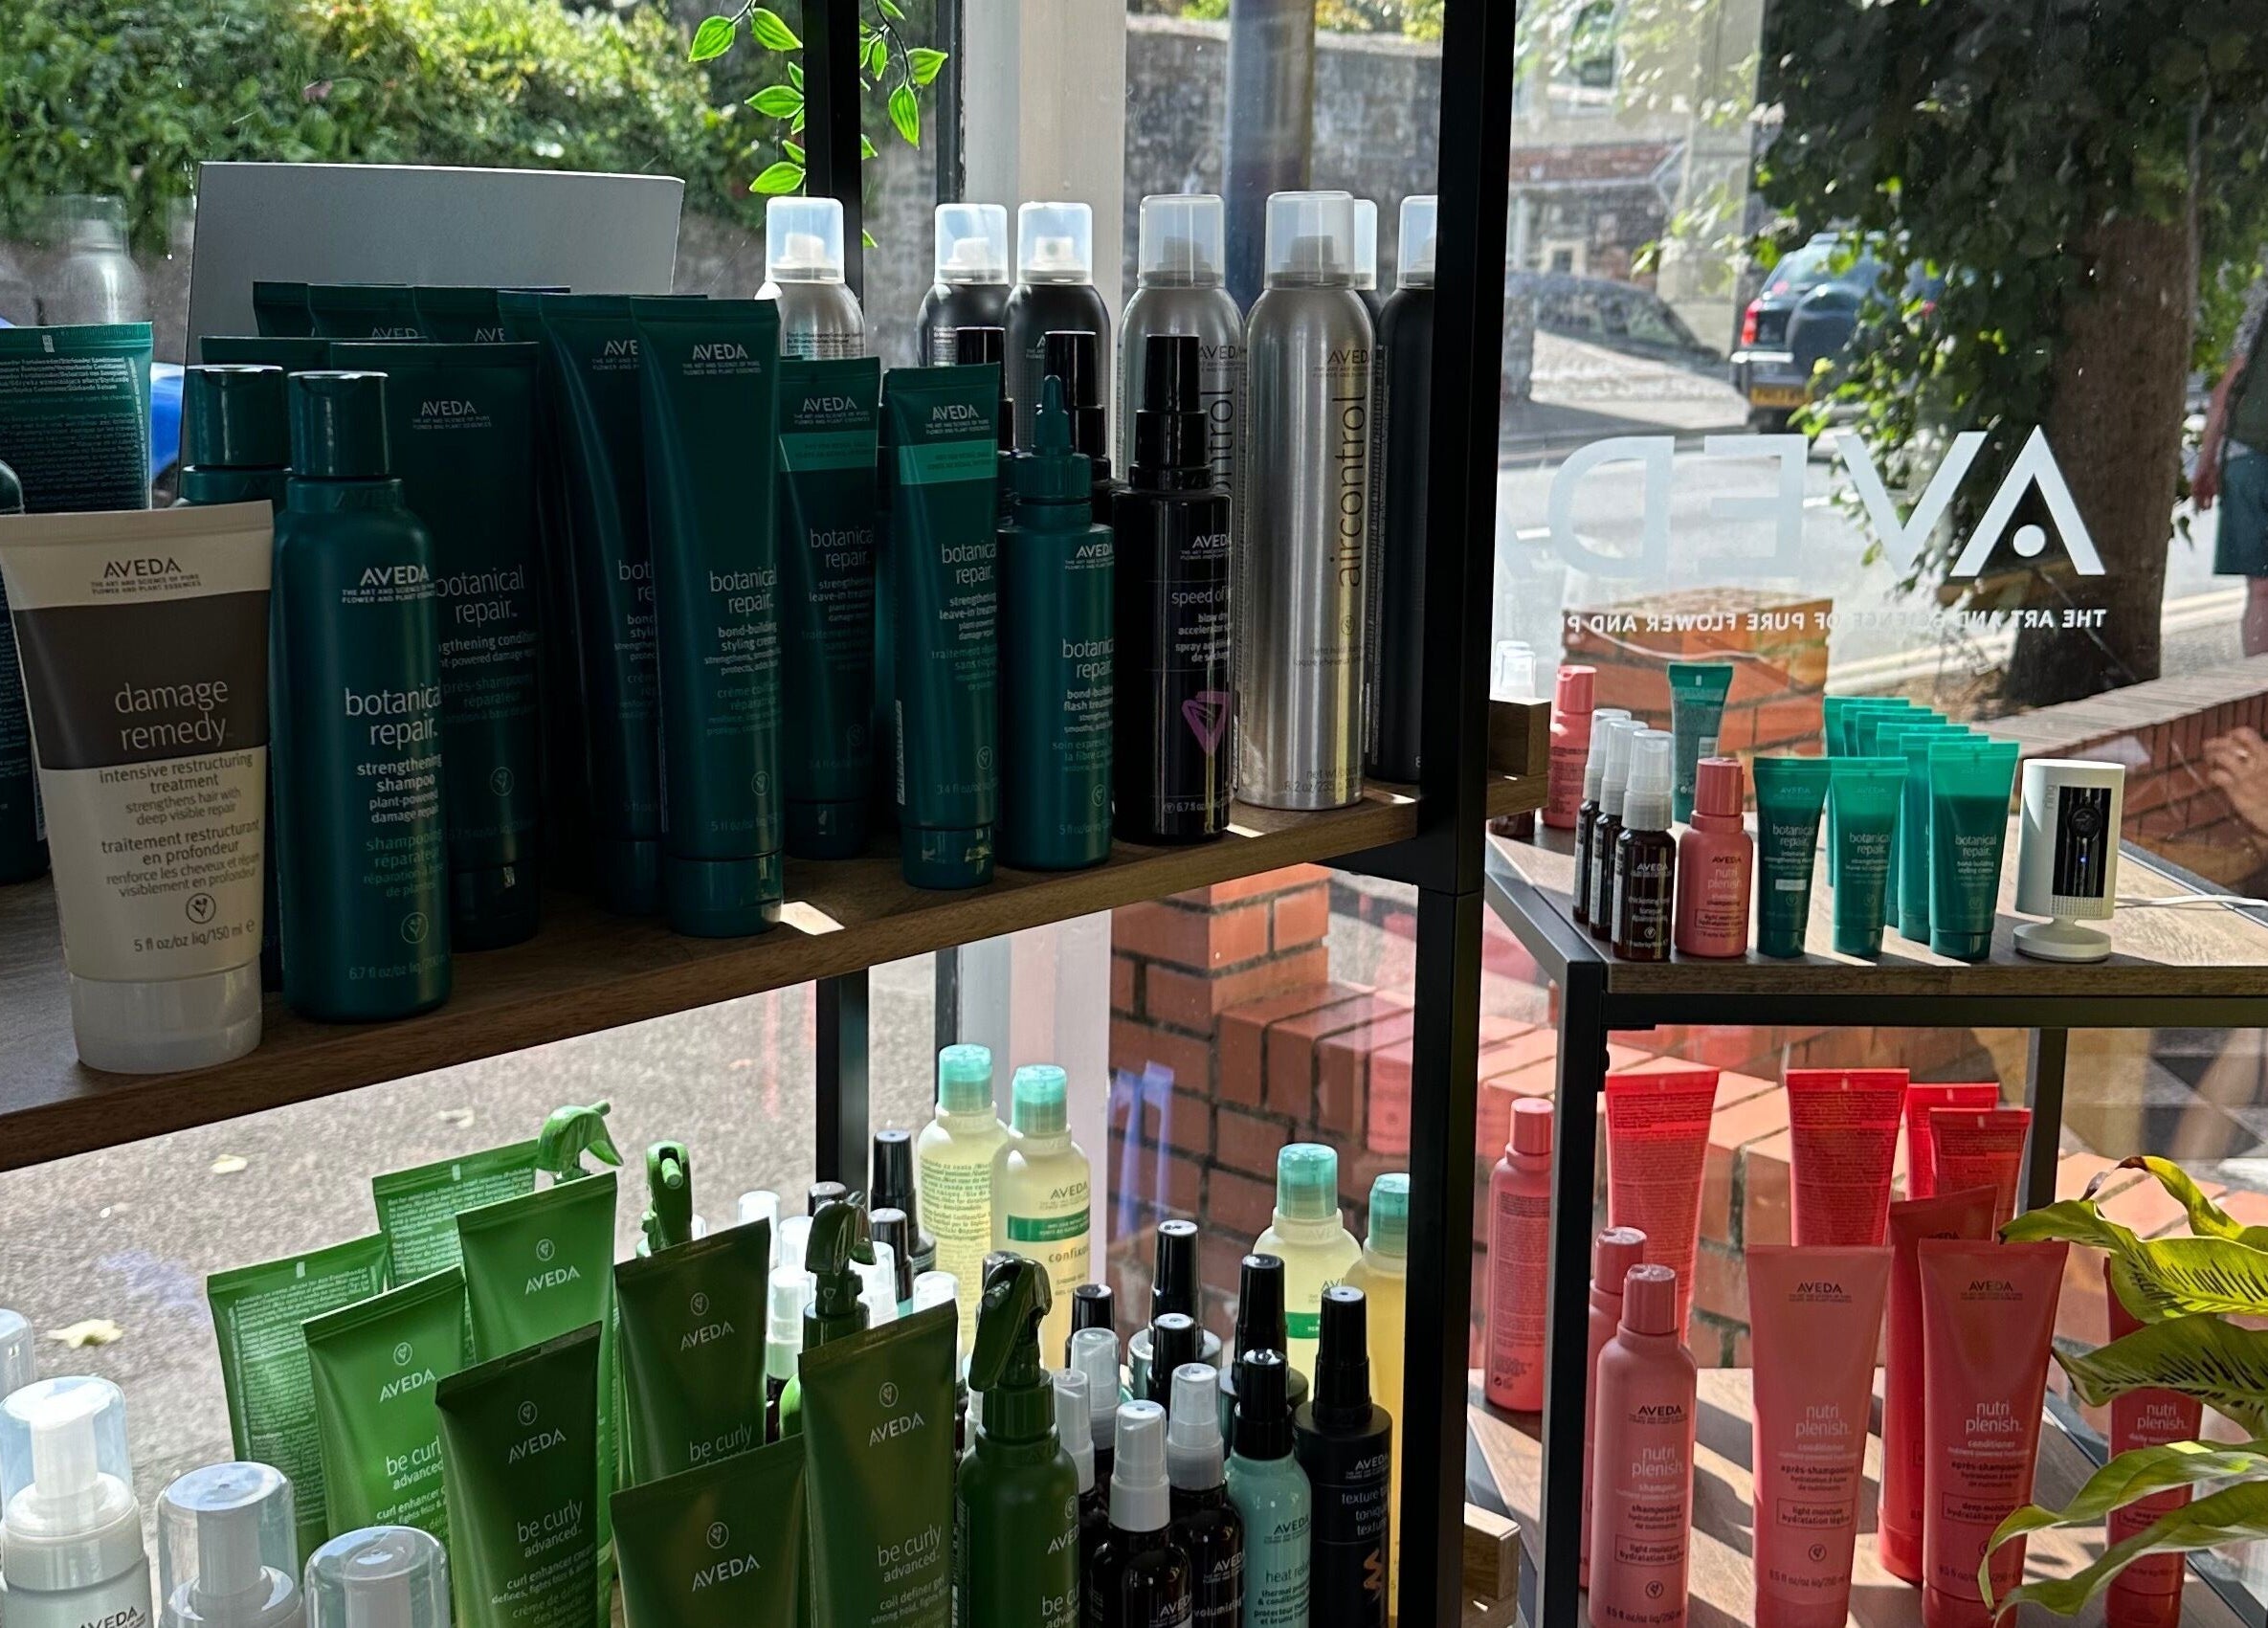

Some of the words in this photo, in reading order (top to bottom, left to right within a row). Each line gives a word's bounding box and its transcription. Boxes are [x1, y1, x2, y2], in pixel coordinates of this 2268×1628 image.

[371, 326, 418, 338] AVED
[474, 328, 505, 342] AVE
[604, 340, 638, 355] AVE
[692, 342, 748, 360] AVEDA
[421, 400, 478, 415] AVEDA
[802, 395, 857, 412] AVEDA
[931, 404, 980, 420] AVEDA
[1330, 394, 1366, 588] aircontrol
[103, 557, 182, 578] AVEDA
[360, 564, 430, 587] AVEDA
[709, 564, 778, 593] botanical
[1171, 587, 1213, 607] speed
[114, 679, 230, 714] damage
[120, 711, 227, 751] remedy
[100, 765, 168, 785] intensive
[171, 753, 254, 777] restructuring
[150, 773, 219, 794] treatment
[376, 773, 436, 793] shampoo
[125, 793, 196, 814] strengthens
[197, 792, 220, 804] hair
[136, 811, 167, 826] deep
[168, 805, 206, 820] visible
[101, 830, 182, 855] traitement
[1955, 834, 1997, 845] botanical
[143, 854, 161, 865] en
[166, 838, 239, 865] profondeur
[106, 870, 158, 885] renforce
[160, 865, 178, 879] les
[119, 879, 189, 898] visiblement
[134, 939, 143, 952] 5
[145, 936, 154, 950] fl
[524, 1264, 581, 1295] AVEDA
[1796, 1282, 1843, 1294] AVEDA
[1968, 1281, 2014, 1292] AVEDA
[679, 1321, 735, 1352] AVEDA
[379, 1368, 436, 1402] AVEDA
[1638, 1403, 1682, 1416] AVEDA
[1806, 1401, 1839, 1419] nutri
[1976, 1399, 2010, 1416] nutri
[2146, 1402, 2177, 1417] nutri
[868, 1412, 925, 1448] AVEDA
[508, 1428, 567, 1465] AVEDA
[689, 1441, 711, 1463] be
[715, 1423, 752, 1456] curly
[1642, 1442, 1676, 1461] nutri
[386, 1454, 409, 1478] be
[411, 1434, 441, 1465] curl
[392, 1456, 444, 1490] advanced
[1632, 1458, 1685, 1479] plenish
[376, 1504, 397, 1520] curl
[397, 1487, 440, 1514] enhancer
[1342, 1490, 1379, 1505] texture
[517, 1521, 541, 1544] be
[544, 1498, 584, 1531] curly
[877, 1544, 901, 1568] be
[903, 1523, 943, 1557] curly
[506, 1572, 528, 1591] curl
[529, 1555, 572, 1582] enhancer
[692, 1553, 761, 1593] AVEDA
[1265, 1567, 1292, 1587] heat
[880, 1594, 900, 1611] coil
[1041, 1595, 1064, 1617] be
